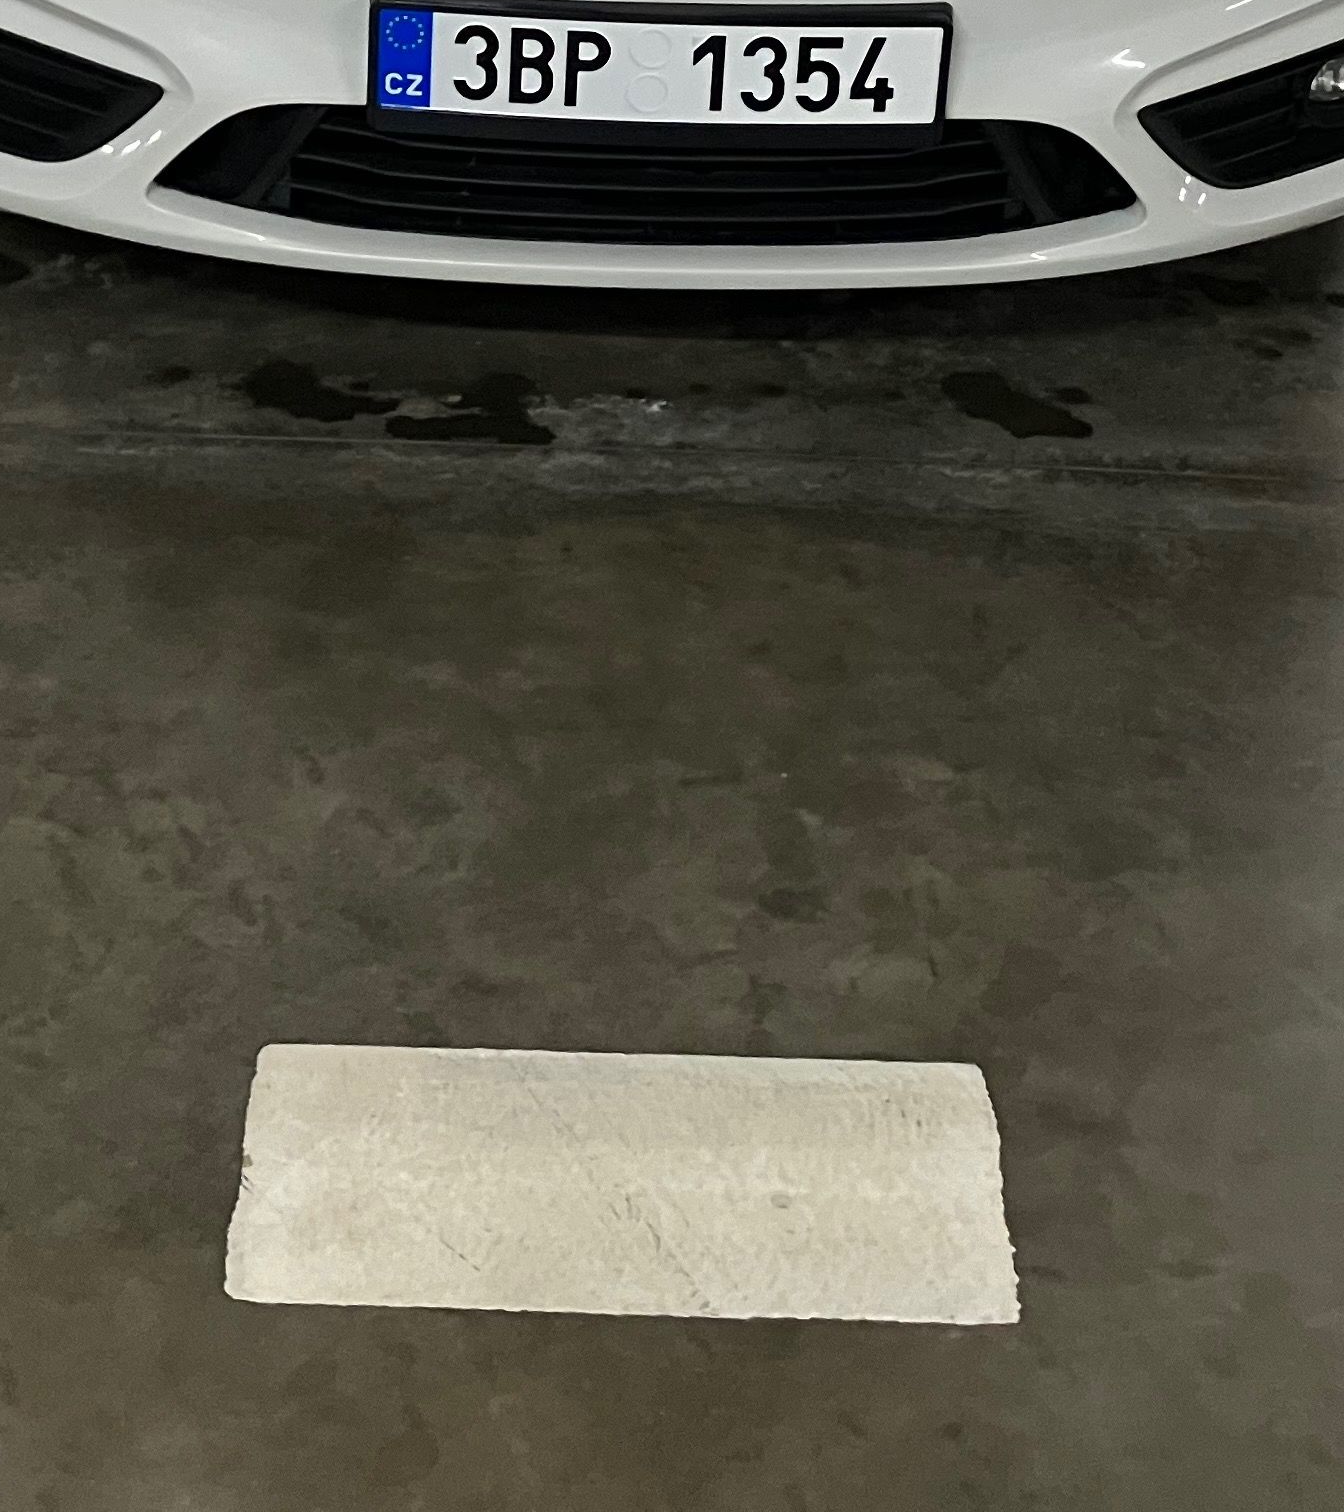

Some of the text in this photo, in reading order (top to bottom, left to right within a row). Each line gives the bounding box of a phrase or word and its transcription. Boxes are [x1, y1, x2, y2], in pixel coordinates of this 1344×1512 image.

[384, 72, 423, 96] CZ
[453, 24, 895, 112] 3BP 1354
